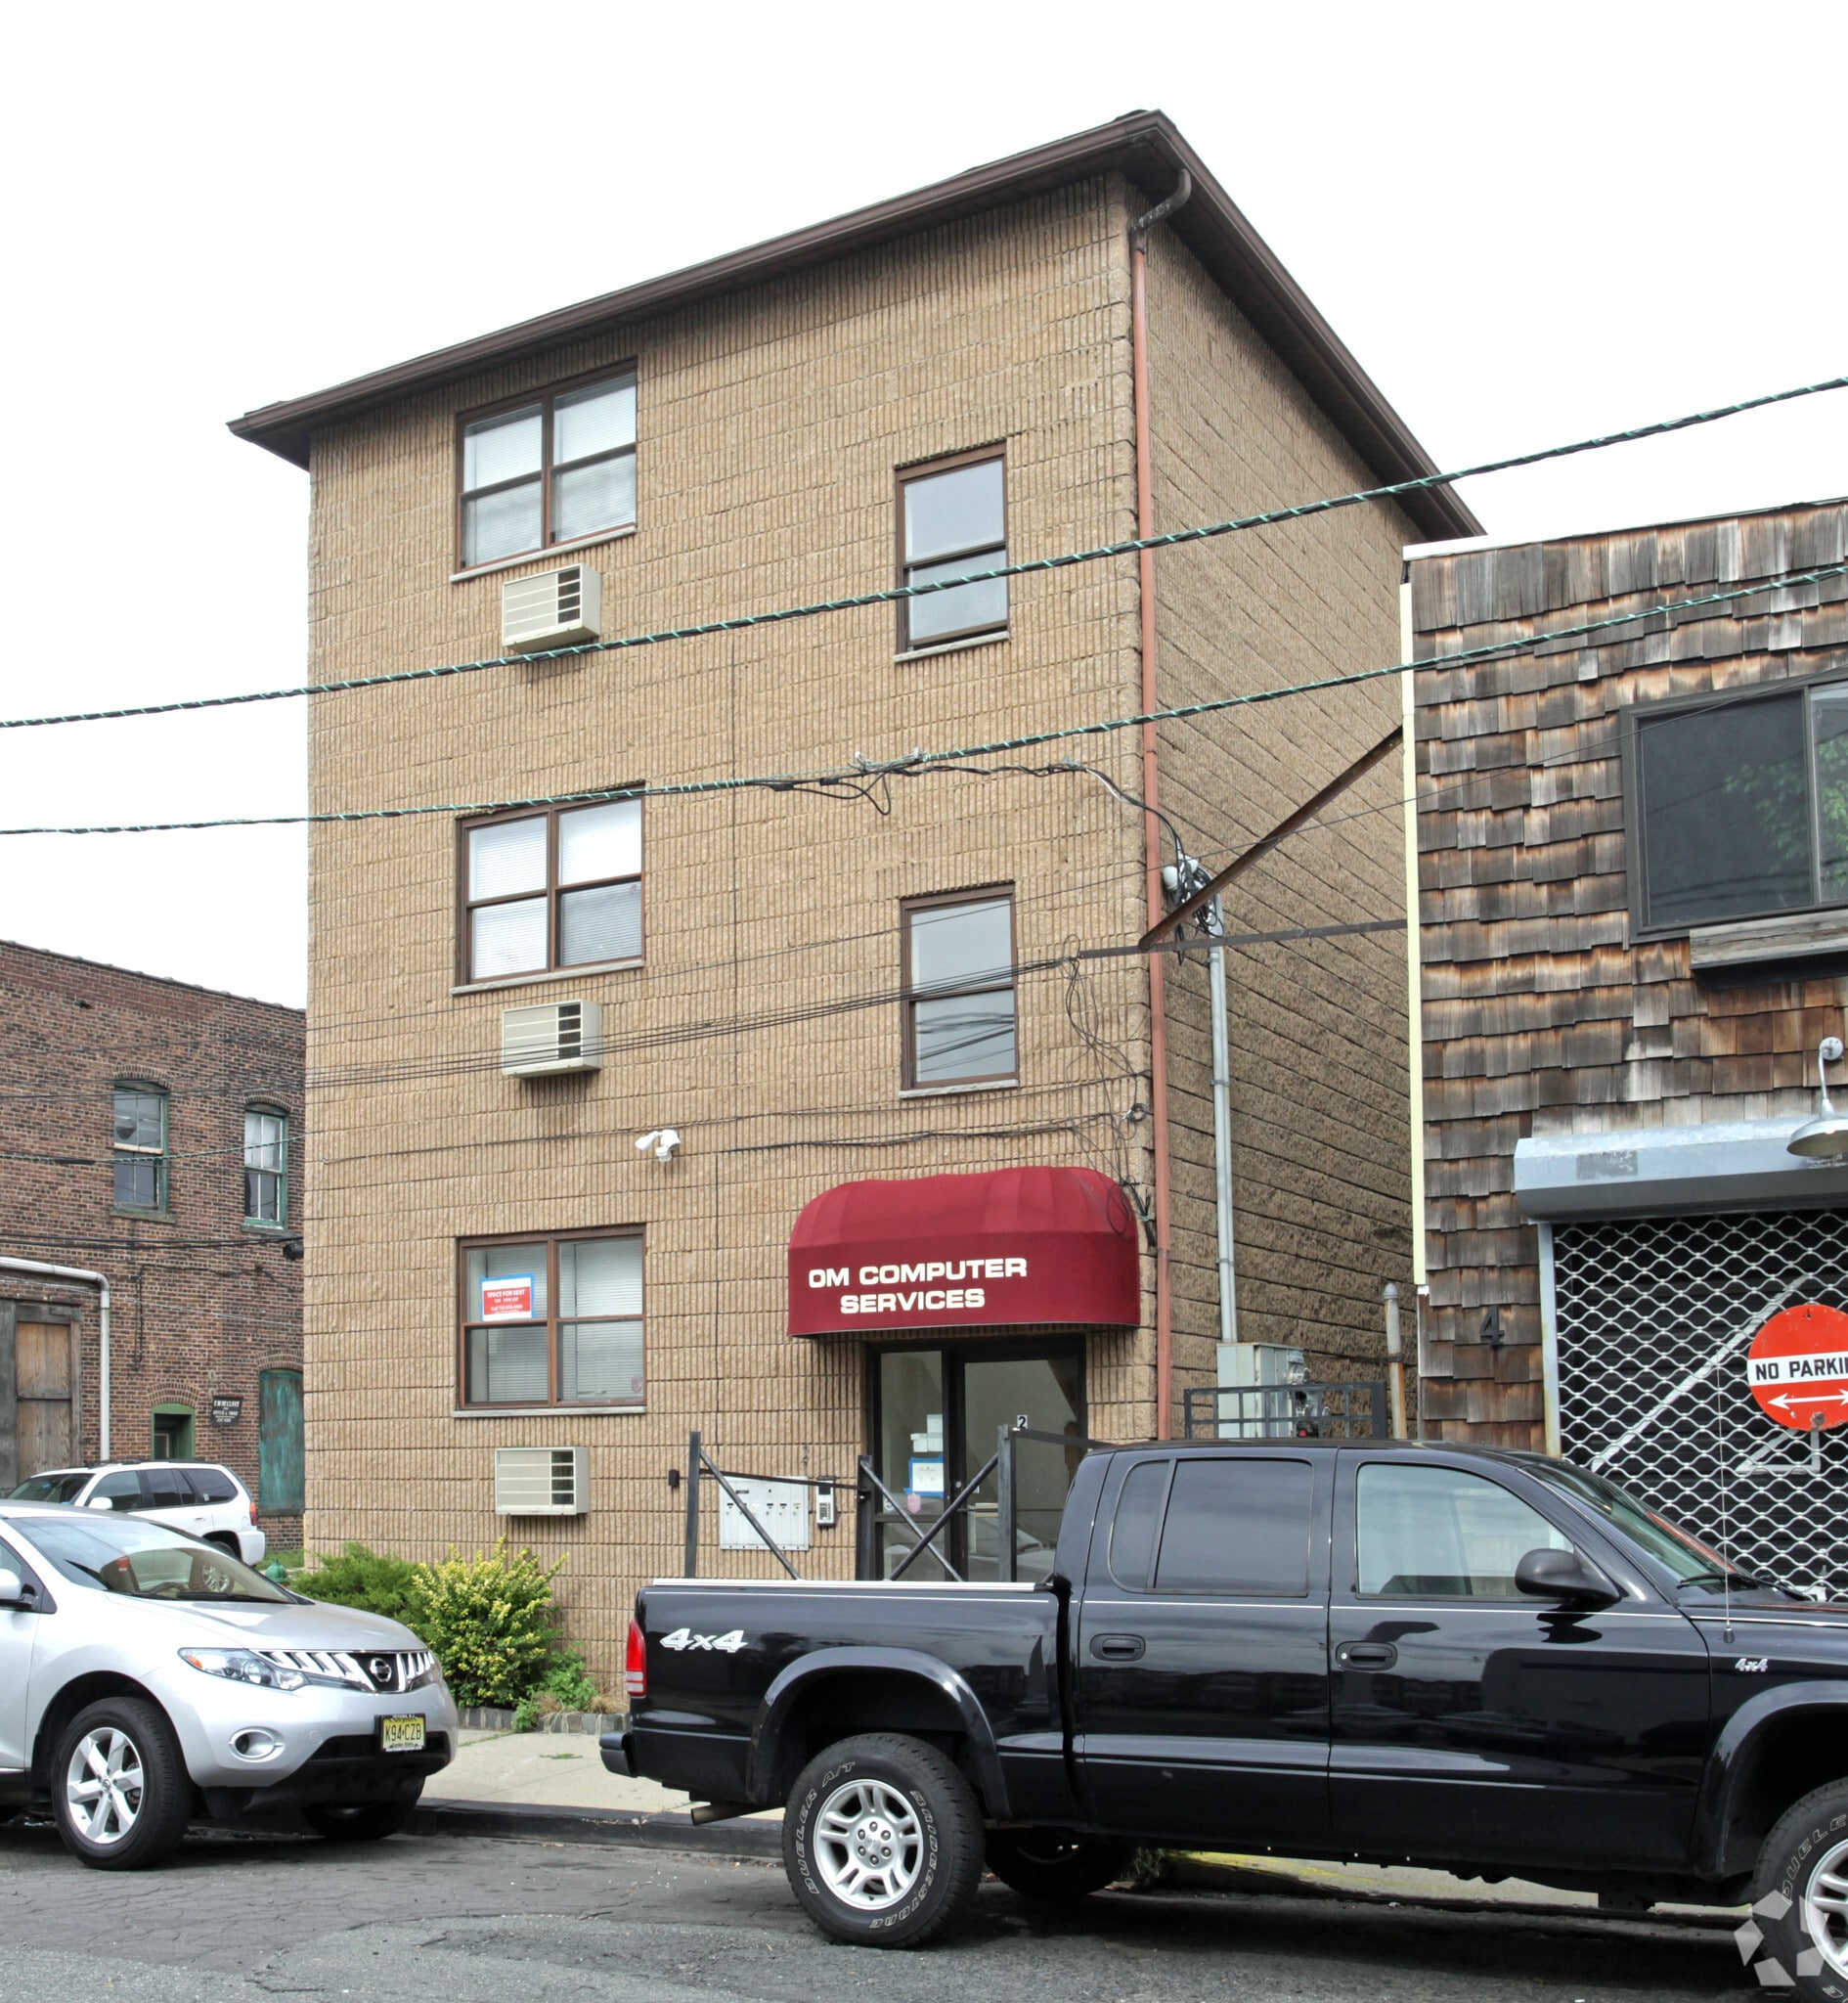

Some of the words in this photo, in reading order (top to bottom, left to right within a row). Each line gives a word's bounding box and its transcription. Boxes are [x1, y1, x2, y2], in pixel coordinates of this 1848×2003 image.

[809, 1269, 850, 1288] OM
[858, 1257, 1028, 1285] COMPUTER
[840, 1288, 986, 1313] SERVICES
[1755, 1362, 1780, 1381] NO
[1789, 1357, 1848, 1378] PARKI
[1019, 1416, 1026, 1429] 2
[659, 1627, 749, 1653] 4x4
[1735, 1658, 1769, 1672] 4x4
[796, 1789, 820, 1894] DUELER
[822, 1761, 857, 1788] A/T
[869, 1790, 939, 1929] BRIDGESTONE
